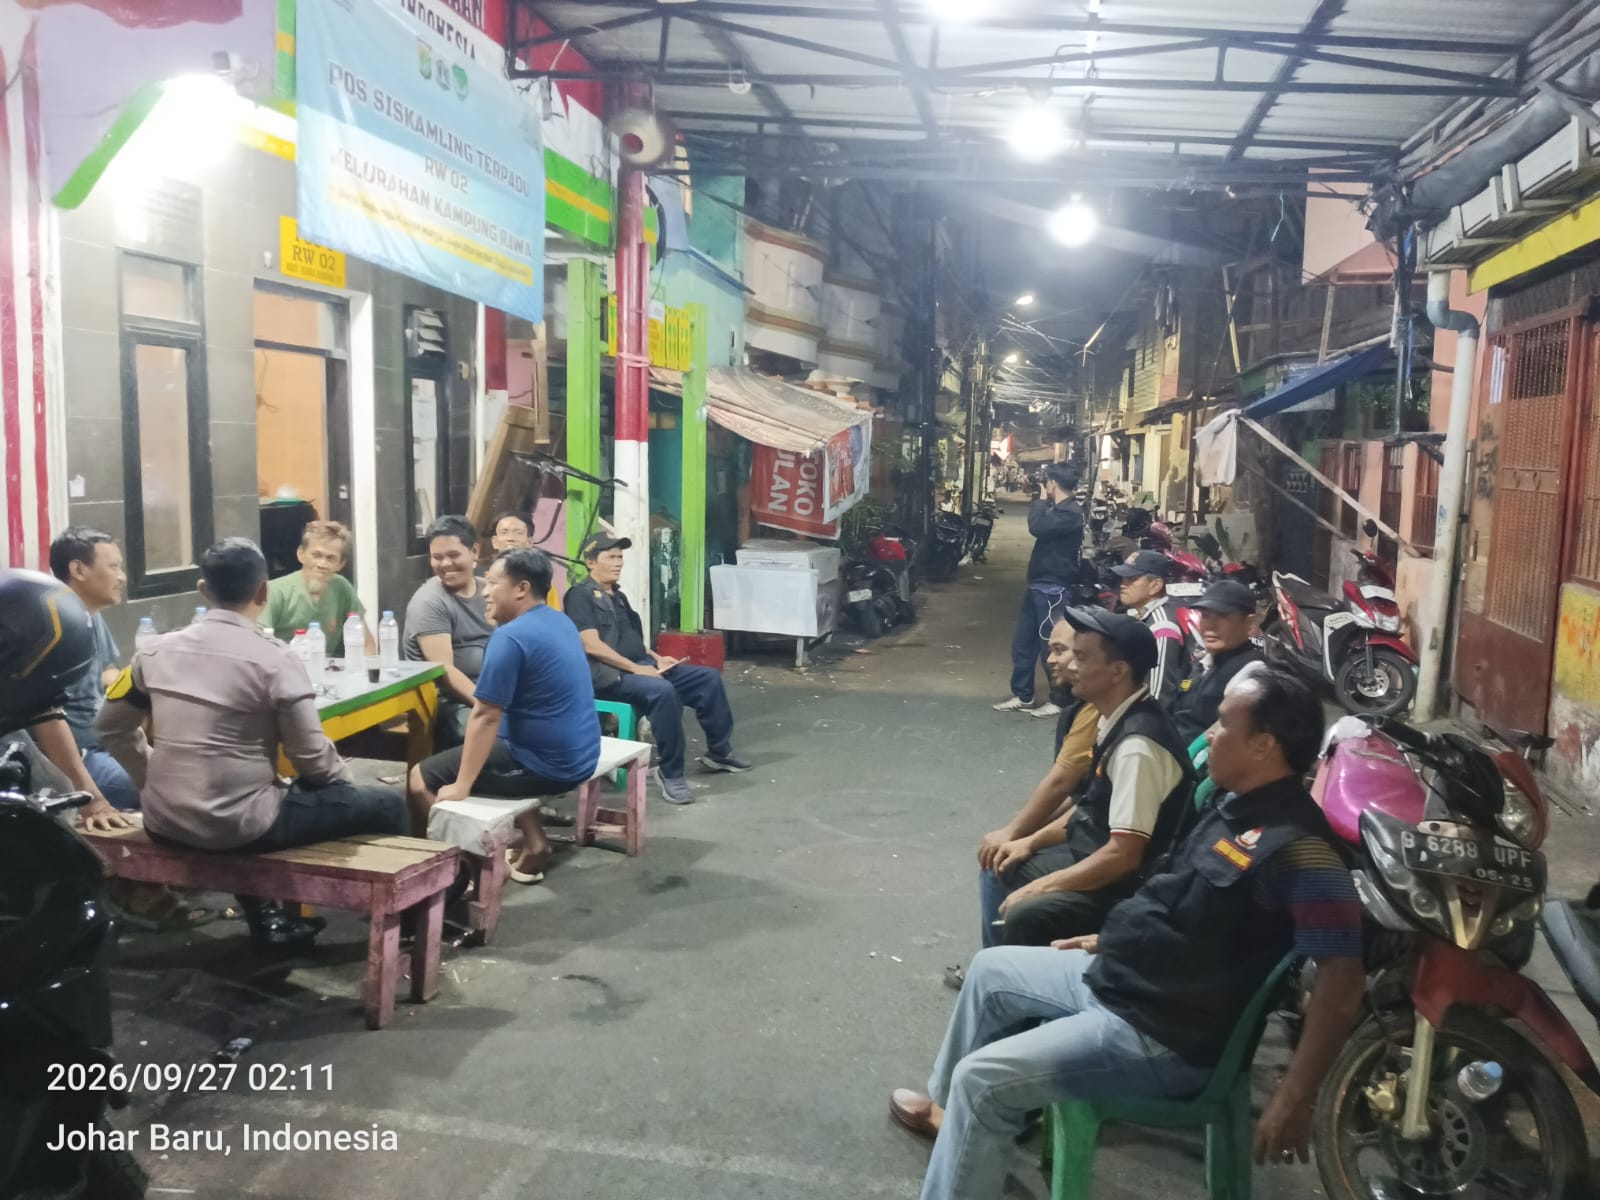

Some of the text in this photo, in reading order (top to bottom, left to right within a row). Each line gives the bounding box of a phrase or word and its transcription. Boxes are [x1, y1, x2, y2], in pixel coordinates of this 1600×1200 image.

[329, 63, 528, 198] POS SISKAMLING TERPADU
[424, 155, 468, 194] RW 02
[434, 195, 497, 242] KAMPUNG
[292, 245, 314, 265] RW
[319, 252, 336, 273] 02
[794, 447, 819, 515] TOKO
[1402, 831, 1532, 868] B 6288 UPF
